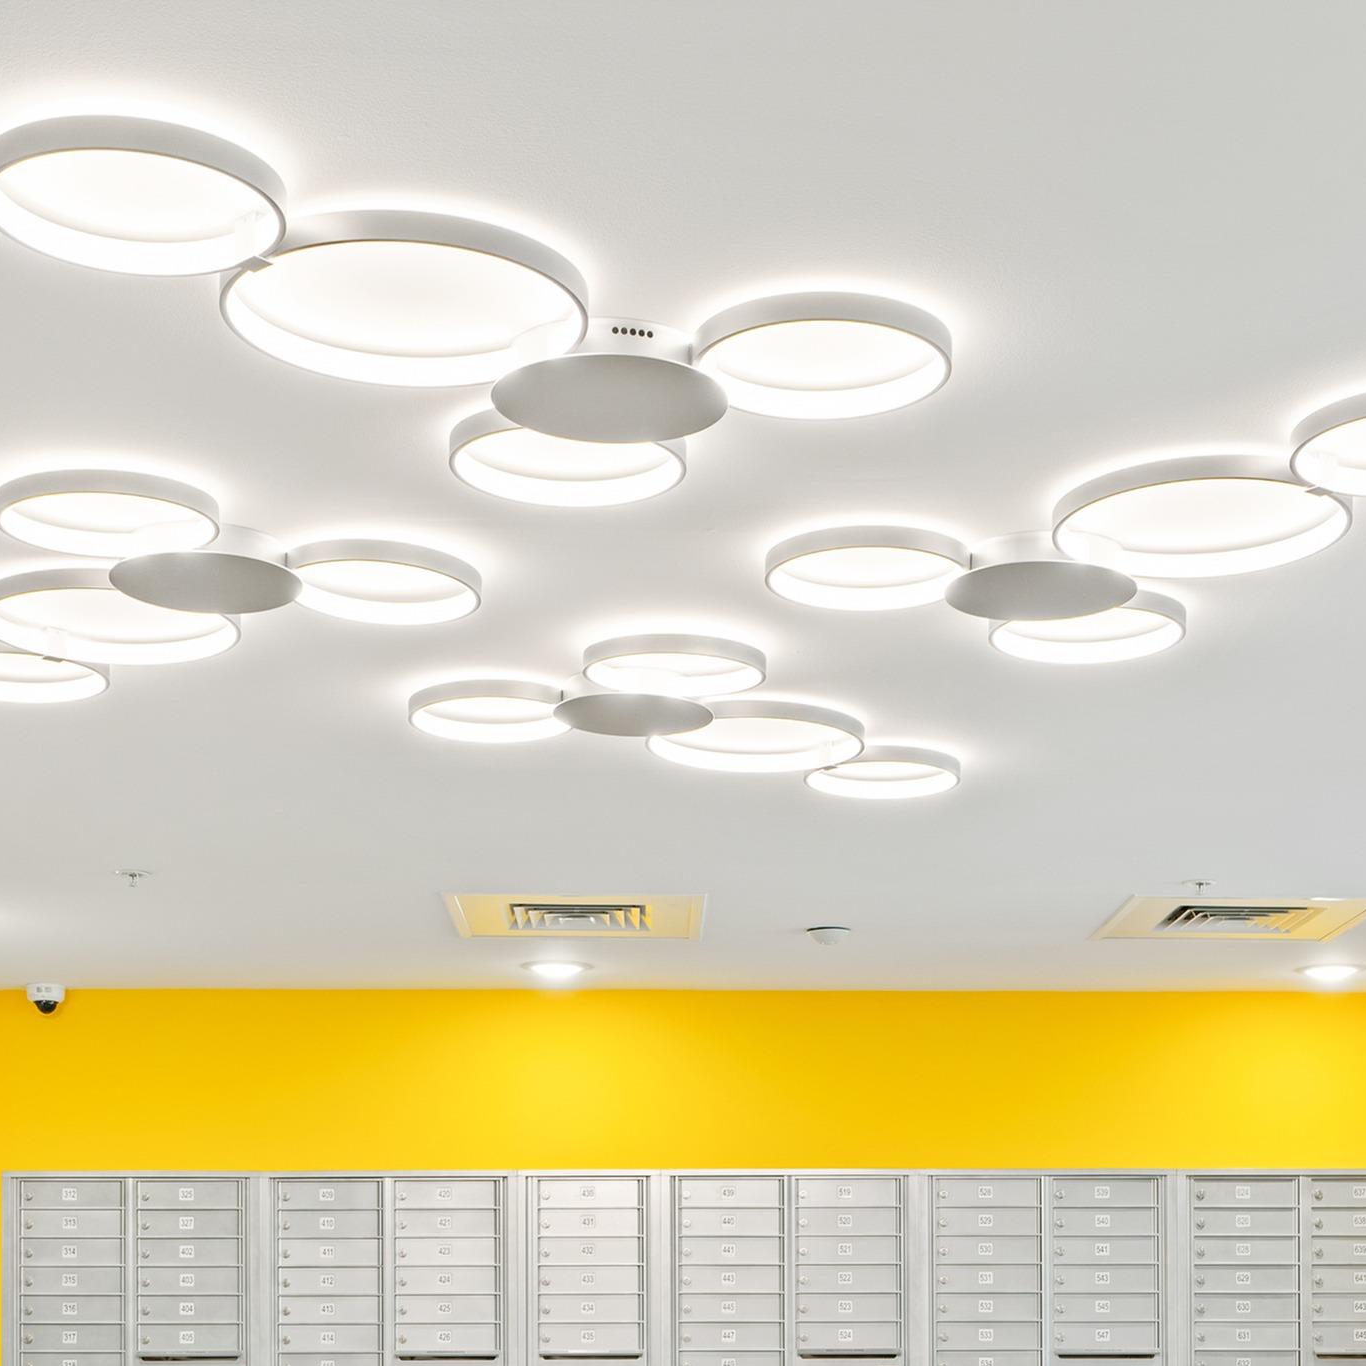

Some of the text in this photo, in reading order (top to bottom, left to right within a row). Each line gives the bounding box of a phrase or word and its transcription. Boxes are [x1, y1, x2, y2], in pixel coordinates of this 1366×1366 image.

[63, 1189, 77, 1199] 312
[1095, 1187, 1109, 1197] 539
[1353, 1187, 1366, 1197] 637
[63, 1218, 77, 1227] 313
[180, 1218, 193, 1228] 327
[438, 1218, 451, 1227] 421
[581, 1217, 594, 1227] 431
[979, 1216, 992, 1225] 529
[63, 1247, 76, 1256] 314
[180, 1247, 194, 1256] 402
[322, 1248, 334, 1256] 411
[581, 1246, 594, 1255] 432
[722, 1246, 735, 1254] 441
[838, 1244, 851, 1254] 521
[1096, 1245, 1108, 1254] 541
[1354, 1244, 1366, 1255] 639
[63, 1275, 77, 1285] 315
[180, 1275, 194, 1285] 403
[321, 1276, 334, 1286] 412
[438, 1275, 451, 1284] 424
[581, 1274, 594, 1284] 433
[722, 1274, 735, 1283] 443
[839, 1273, 852, 1282] 522
[979, 1273, 992, 1282] 531
[1096, 1273, 1109, 1283] 543
[1236, 1273, 1250, 1283] 629
[1354, 1274, 1366, 1283] 641
[63, 1304, 76, 1313] 316
[180, 1304, 194, 1313] 404
[321, 1304, 334, 1313] 413
[438, 1303, 451, 1313] 425
[581, 1303, 594, 1313] 434
[722, 1302, 735, 1312] 445
[838, 1301, 852, 1311] 523
[979, 1301, 992, 1311] 532
[1236, 1302, 1250, 1312] 630
[1354, 1302, 1366, 1311] 643
[64, 1332, 76, 1342] 317
[321, 1333, 335, 1342] 414
[581, 1331, 595, 1341] 435
[722, 1331, 735, 1339] 447
[839, 1330, 852, 1340] 524
[979, 1330, 993, 1340] 533
[1097, 1330, 1109, 1340] 547
[1237, 1331, 1250, 1340] 631
